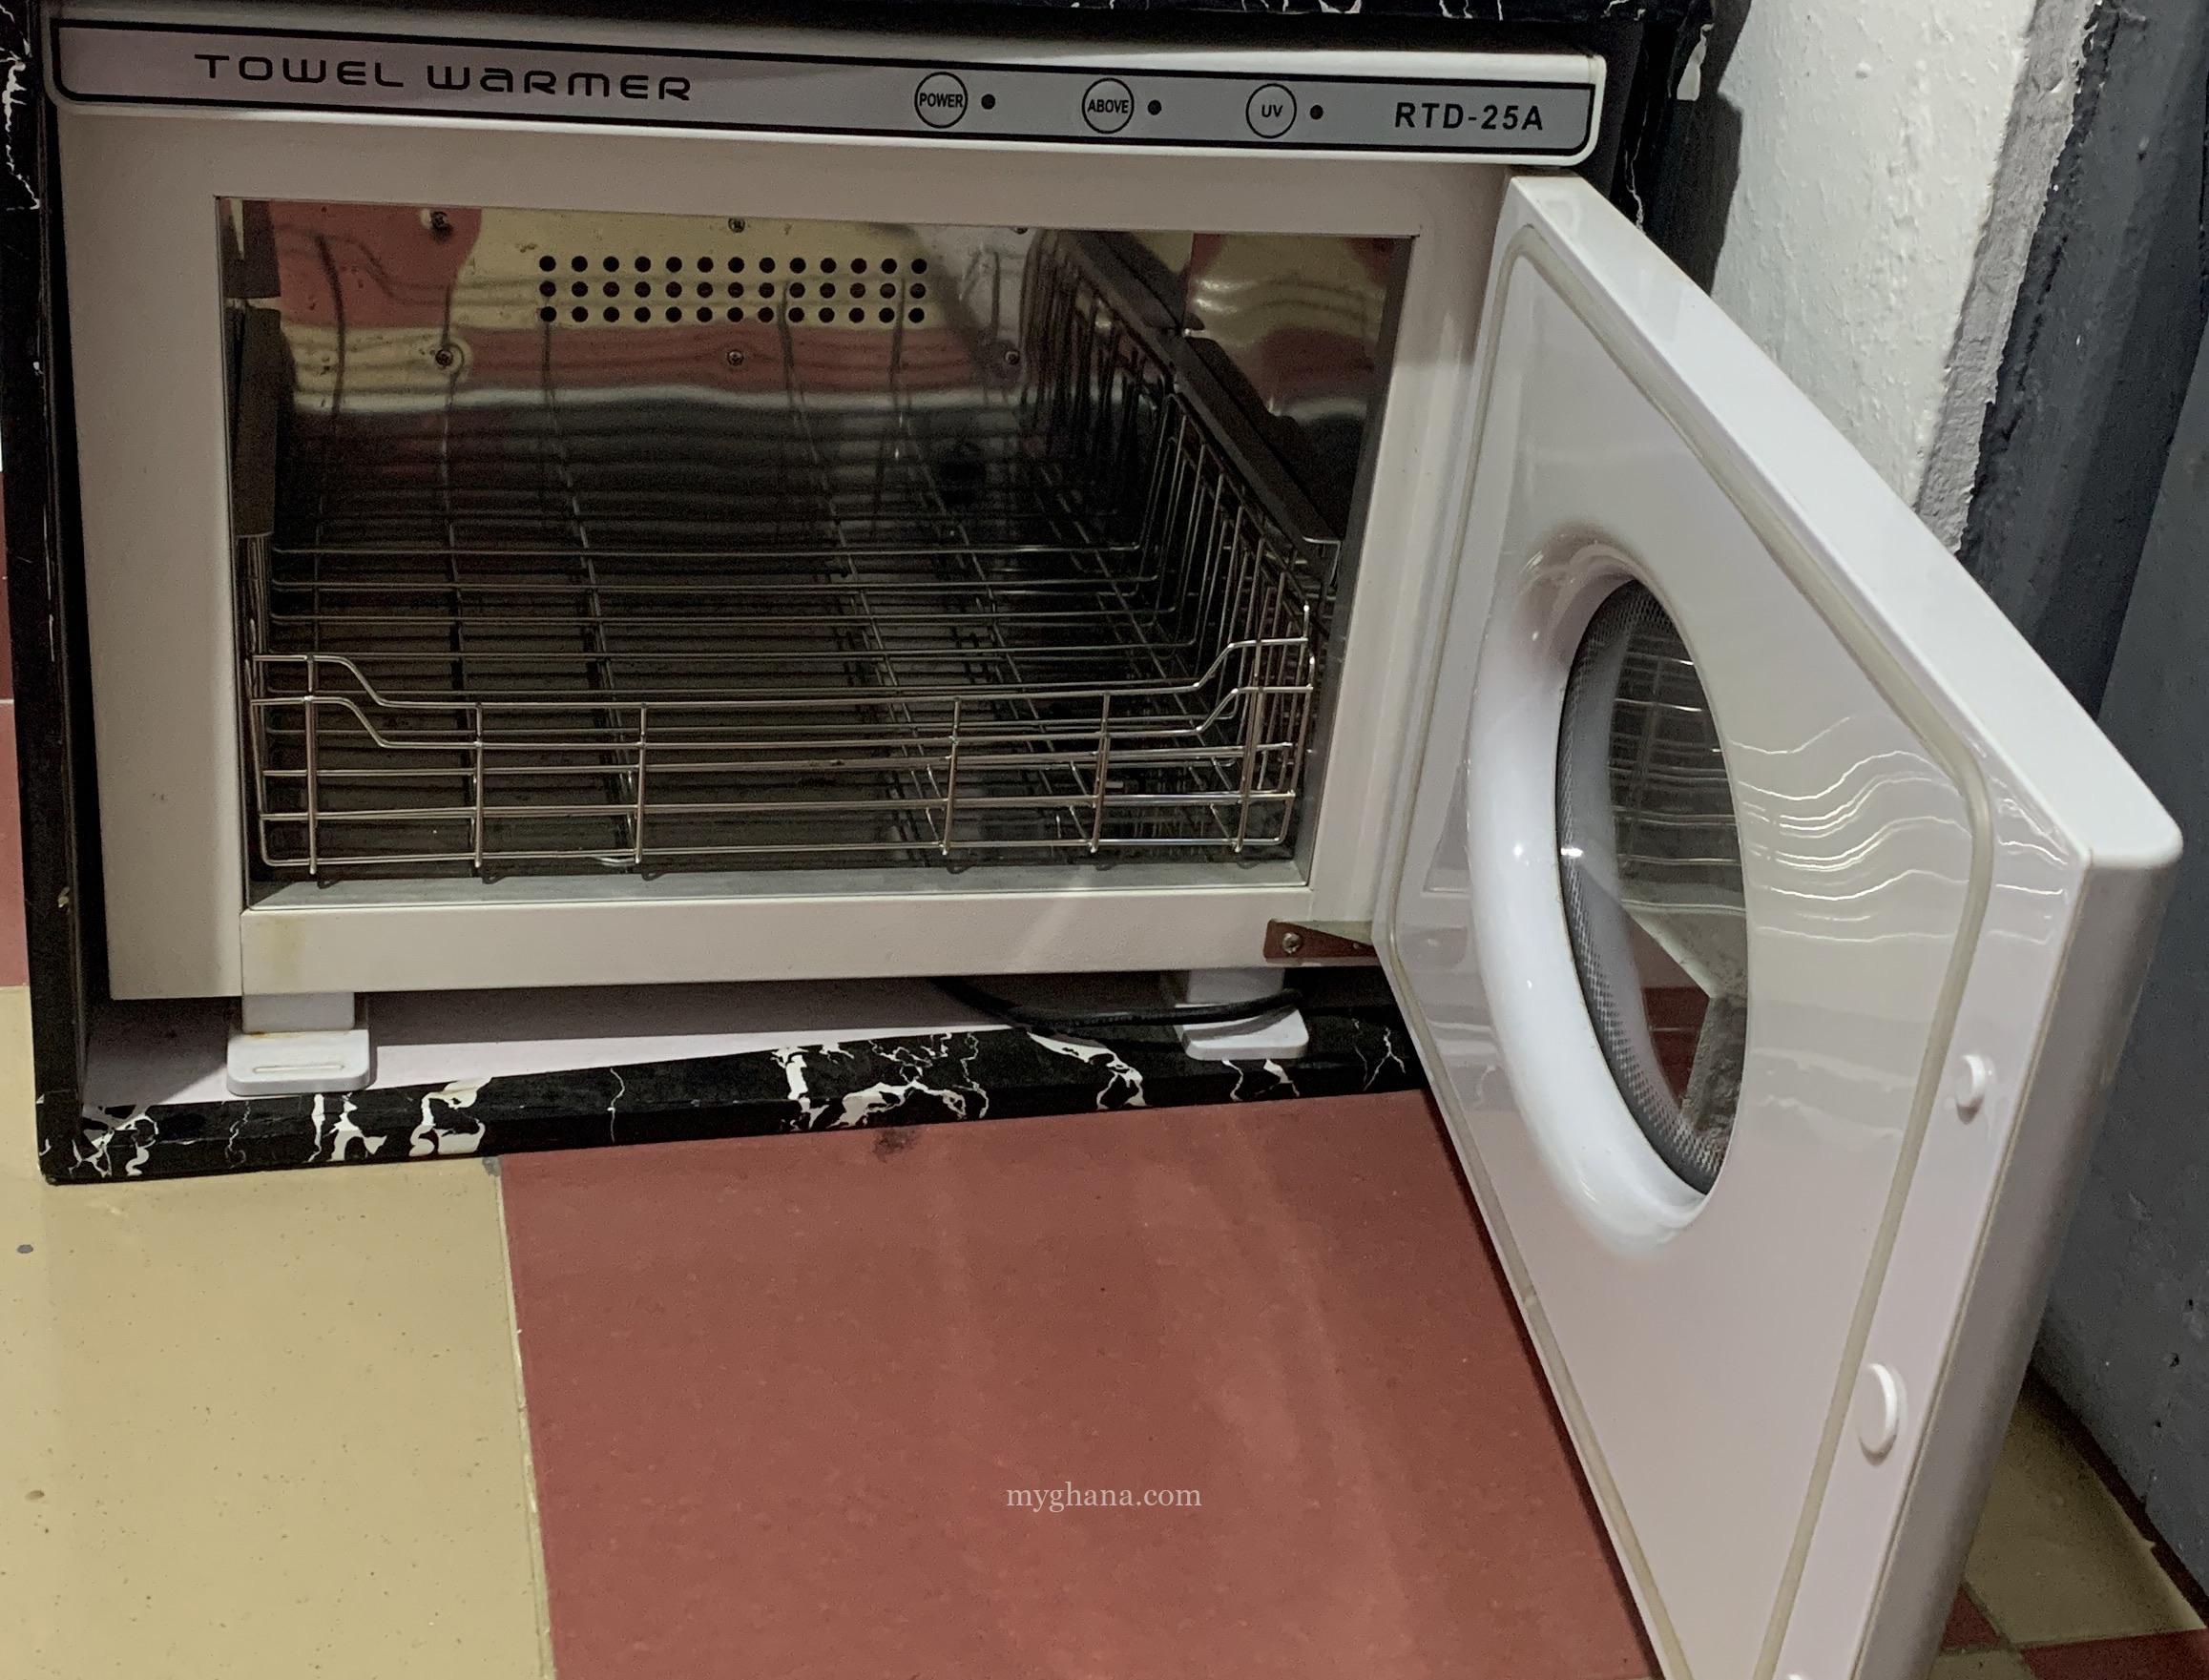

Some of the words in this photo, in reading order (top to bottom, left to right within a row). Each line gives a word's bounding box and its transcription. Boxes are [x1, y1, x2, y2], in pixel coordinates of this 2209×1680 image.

[194, 54, 405, 87] TOWEL
[919, 92, 964, 108] POWER
[1087, 99, 1129, 114] ABOVE
[1261, 104, 1282, 118] UV
[1394, 102, 1543, 132] RTD-25A
